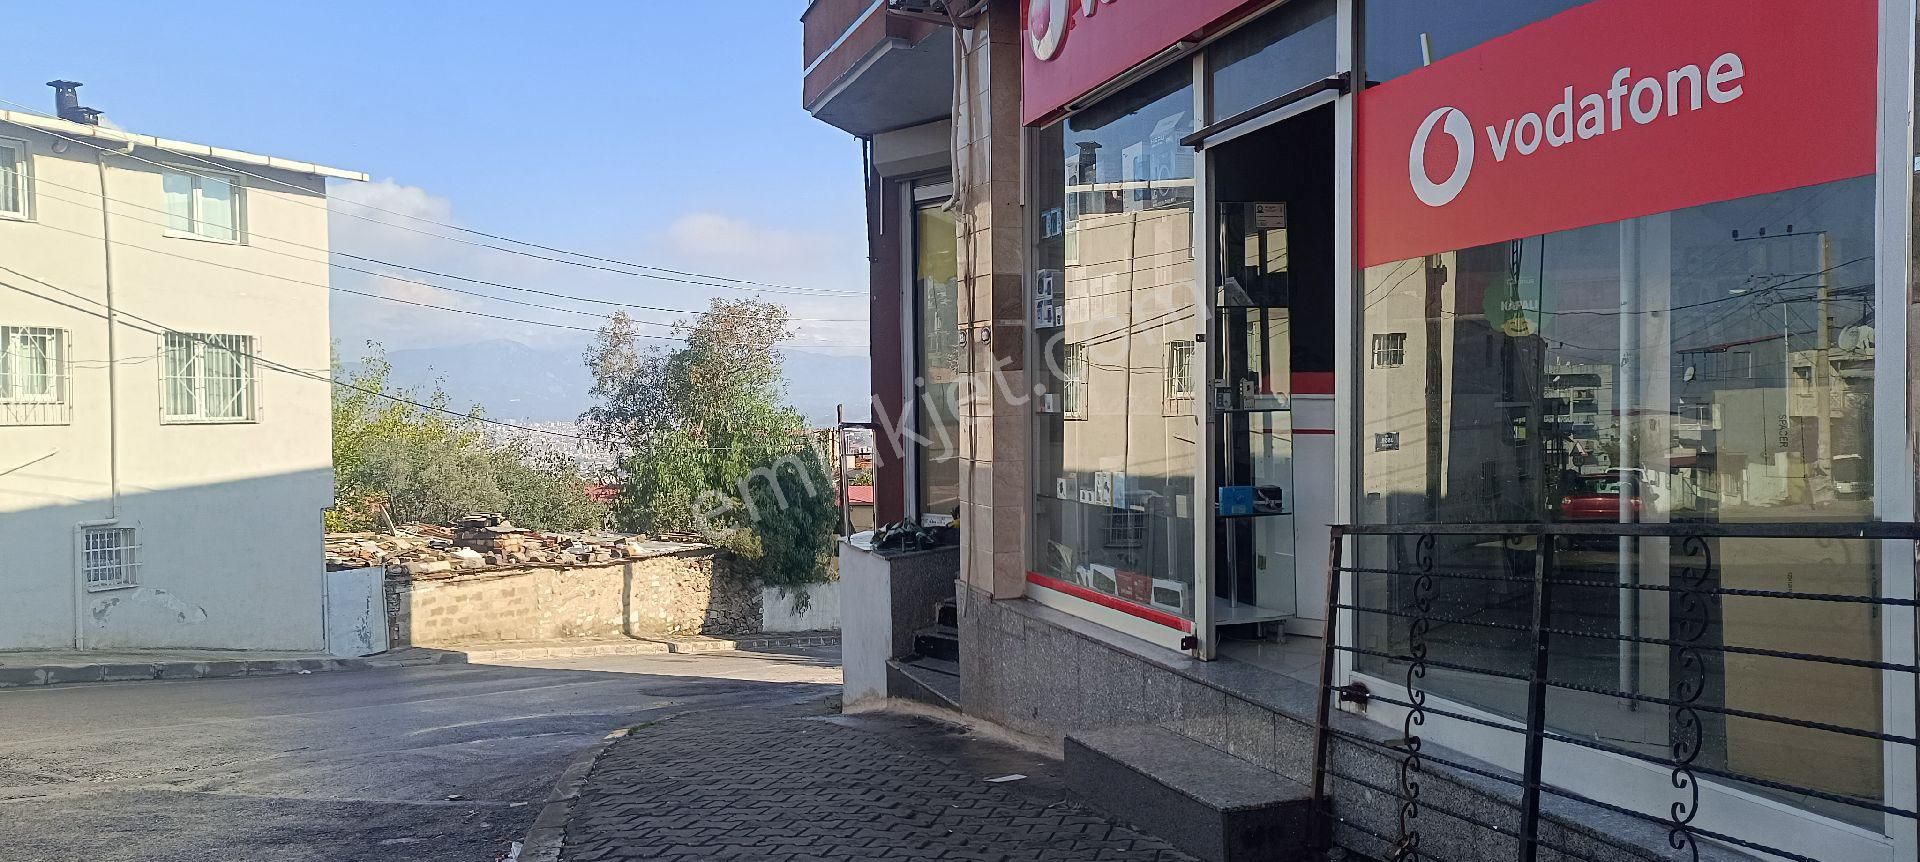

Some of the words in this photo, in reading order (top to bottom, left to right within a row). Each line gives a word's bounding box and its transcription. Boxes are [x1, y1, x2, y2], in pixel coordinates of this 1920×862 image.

[1485, 52, 1745, 162] vodafone
[1500, 299, 1539, 311] KAPALI
[1778, 414, 1789, 448] SPACER
